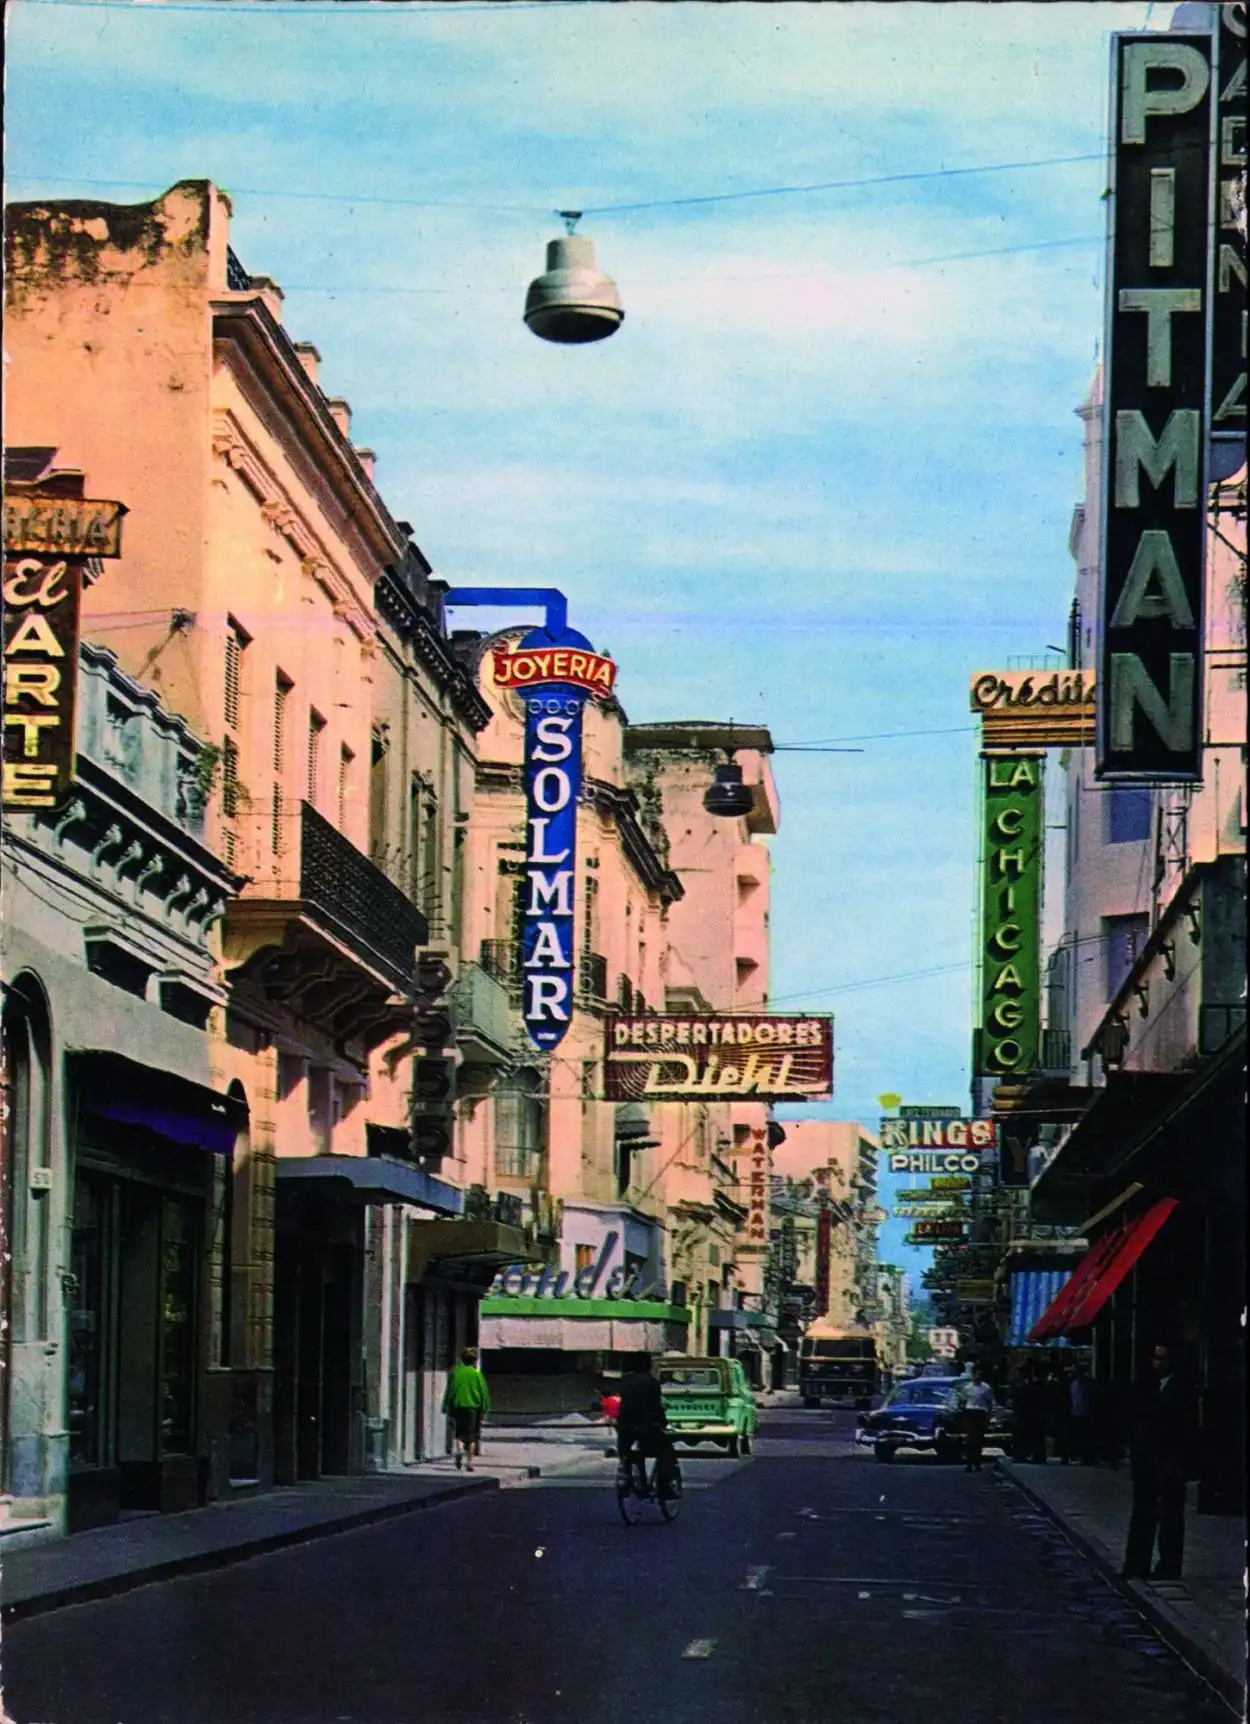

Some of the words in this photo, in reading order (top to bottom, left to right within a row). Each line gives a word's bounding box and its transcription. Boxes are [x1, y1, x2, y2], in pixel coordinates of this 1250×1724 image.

[1109, 43, 1210, 752] PITMAN
[4, 558, 68, 606] El
[494, 652, 612, 687] JOYERIA
[4, 614, 66, 807] ARTE
[989, 759, 1035, 787] LA
[523, 716, 574, 1021] SOLMAR
[994, 808, 1025, 1067] CHICAGO
[613, 1021, 823, 1045] DESPERTADORES
[751, 1128, 767, 1240] WATERMAN
[891, 1154, 980, 1173] PHILCO
